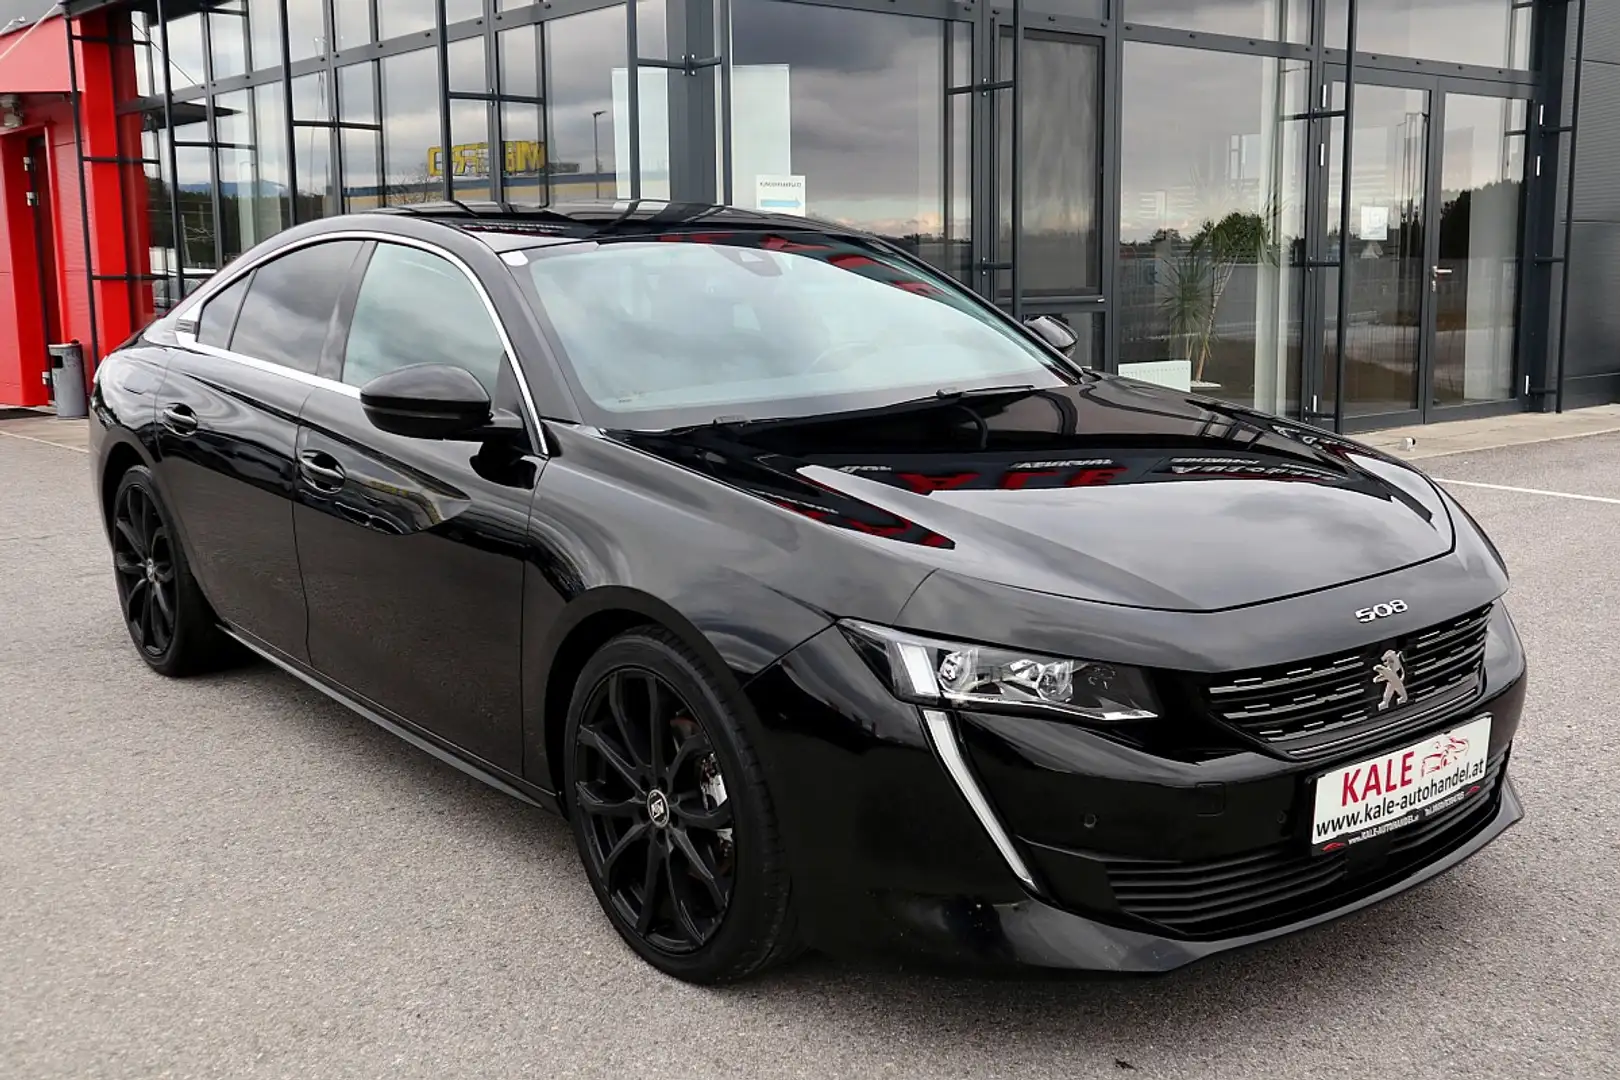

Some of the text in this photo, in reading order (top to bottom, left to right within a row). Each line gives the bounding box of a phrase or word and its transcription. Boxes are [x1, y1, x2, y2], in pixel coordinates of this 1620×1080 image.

[1355, 599, 1408, 623] 508
[1316, 758, 1484, 837] www.kale-autohandel.at
[1341, 751, 1415, 807] KALE
